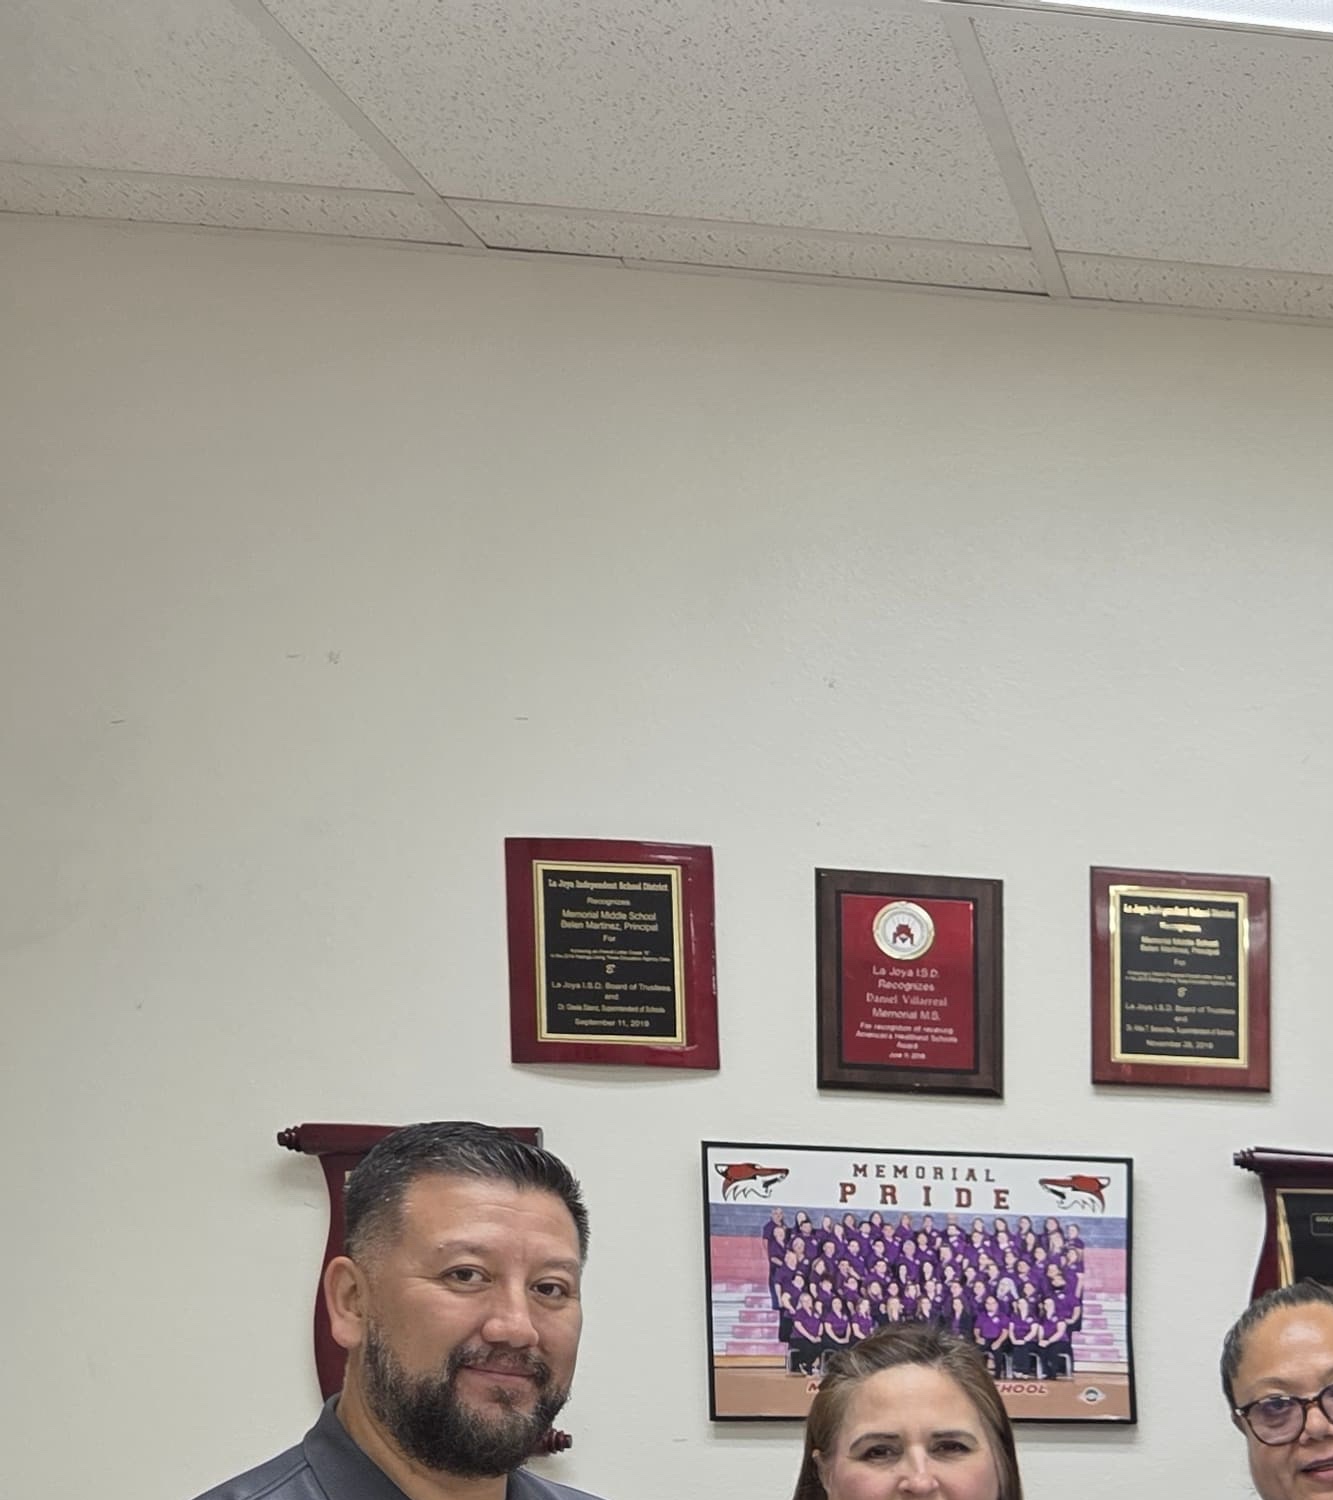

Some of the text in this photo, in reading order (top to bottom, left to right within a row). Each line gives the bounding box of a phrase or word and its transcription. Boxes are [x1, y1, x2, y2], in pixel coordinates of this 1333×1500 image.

[562, 909, 656, 920] Memorial Middle School
[624, 922, 659, 932] Principal
[872, 965, 886, 976] La
[889, 967, 913, 978] Joya
[878, 978, 935, 992] Recognizes
[866, 992, 948, 1007] Daniel Villarreal
[872, 1007, 917, 1019] Memorial
[852, 1163, 996, 1183] MEMORIAL
[838, 1181, 1010, 1210] PRIDE
